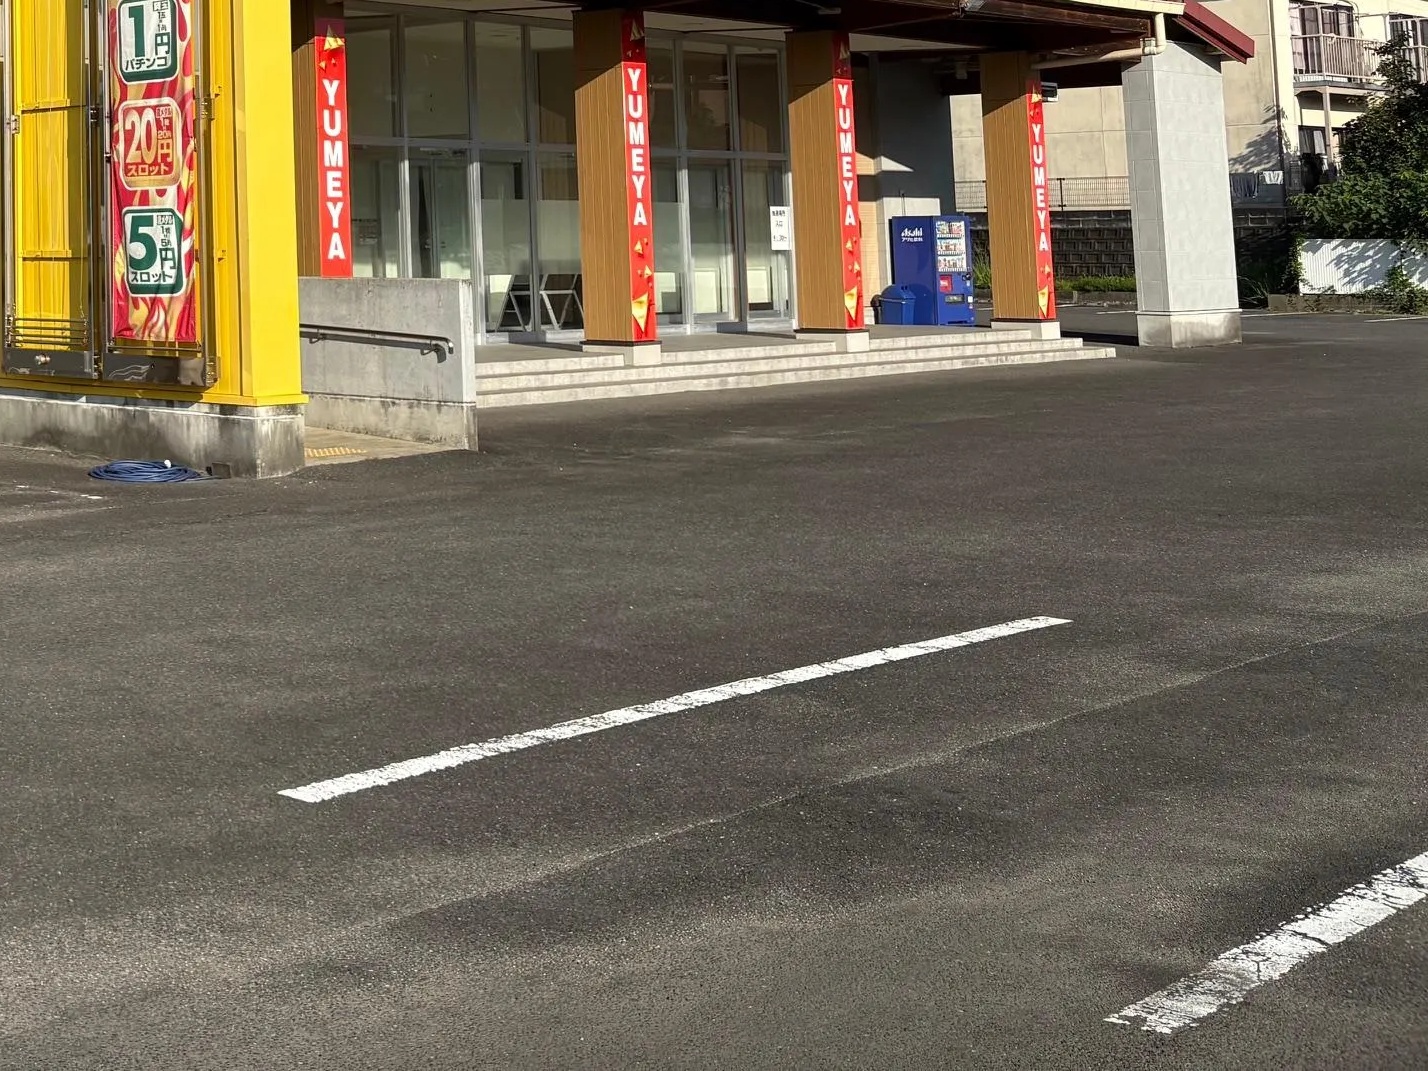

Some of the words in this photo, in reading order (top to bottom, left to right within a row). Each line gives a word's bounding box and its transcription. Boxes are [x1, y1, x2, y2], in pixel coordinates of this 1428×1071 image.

[125, 56, 168, 71] パチンコ
[127, 163, 169, 177] スロット
[322, 79, 345, 260] YUMEYA
[628, 67, 648, 226] YUMEYA
[837, 83, 856, 226] YUMEYA
[1031, 122, 1048, 252] YUMEYA
[900, 227, 923, 237] Asahi
[130, 271, 173, 283] スロット
